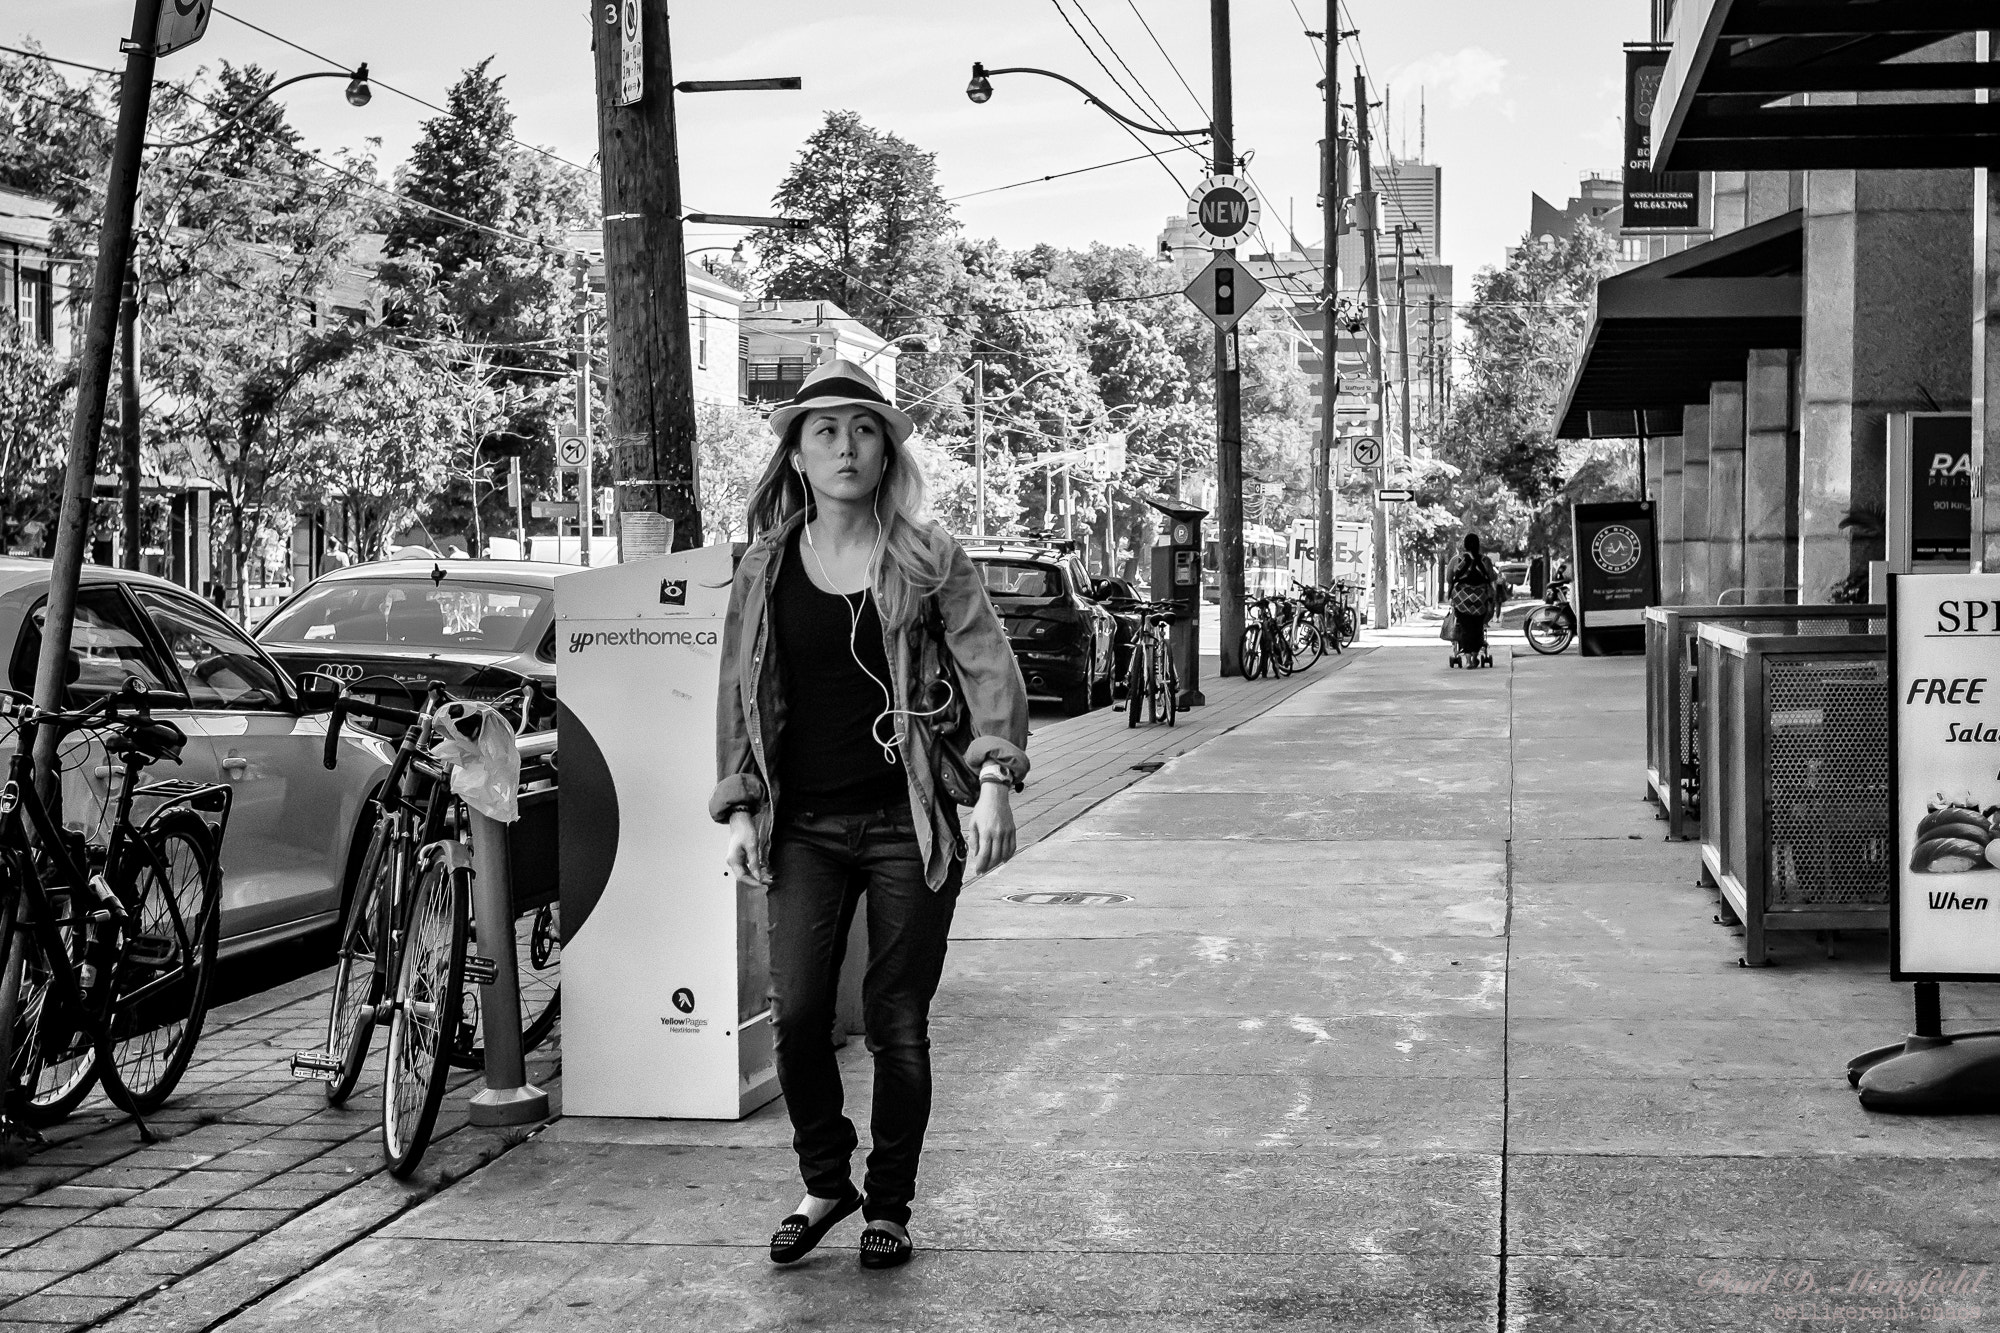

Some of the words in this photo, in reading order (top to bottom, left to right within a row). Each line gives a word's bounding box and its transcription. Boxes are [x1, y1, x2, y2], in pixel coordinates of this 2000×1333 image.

[605, 4, 618, 25] 3
[1637, 149, 1650, 157] BO
[1629, 160, 1650, 169] OFFI
[1202, 201, 1246, 224] NEW
[1633, 201, 1689, 210] 416.645.7044
[1929, 453, 1972, 477] RA
[1928, 477, 1970, 487] PRIN
[1933, 501, 1950, 511] 901
[1294, 538, 1364, 563] FeEx
[569, 628, 718, 653] ypnexthome.ca
[1906, 678, 1988, 705] FREE
[1945, 722, 2000, 743] Sala
[1928, 891, 1989, 910] When
